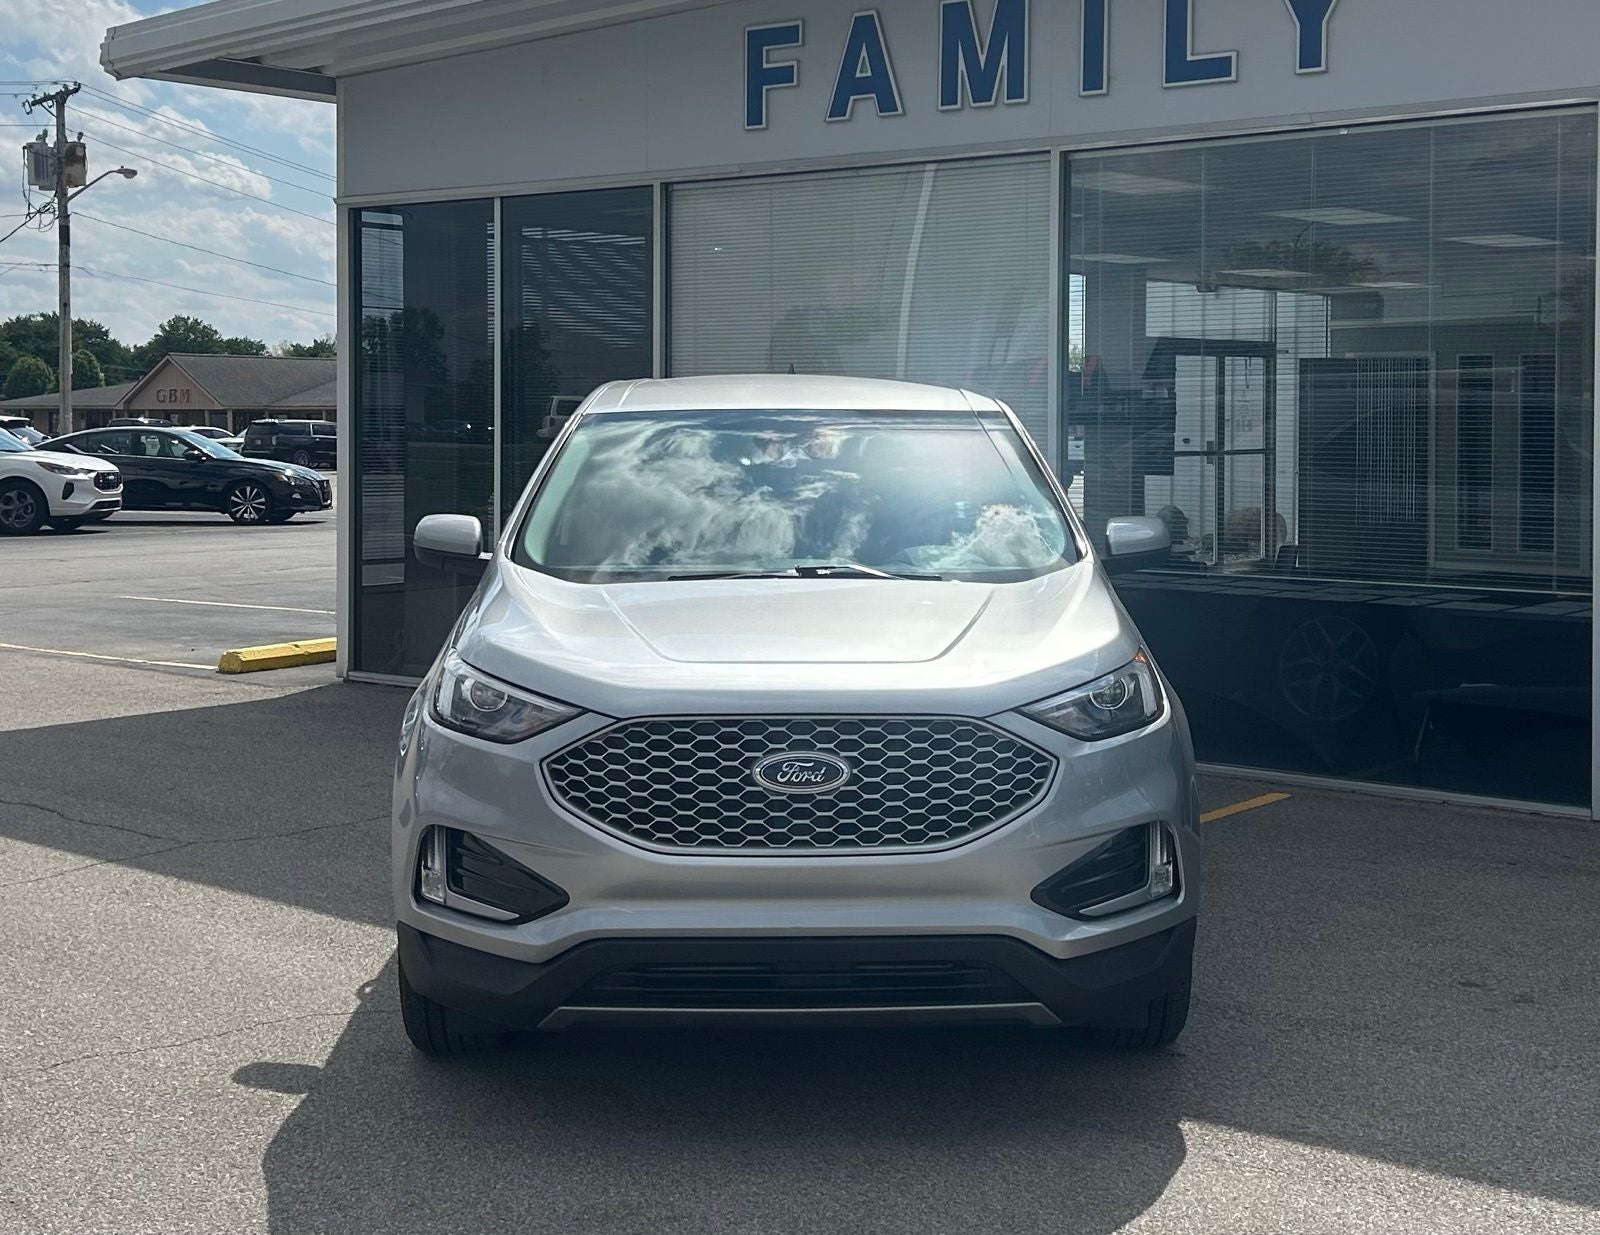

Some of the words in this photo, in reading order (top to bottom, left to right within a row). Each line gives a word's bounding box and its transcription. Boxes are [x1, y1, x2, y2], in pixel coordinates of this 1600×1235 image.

[743, 0, 1337, 130] FAMILY
[156, 388, 190, 403] GBM
[776, 761, 827, 783] Ford
